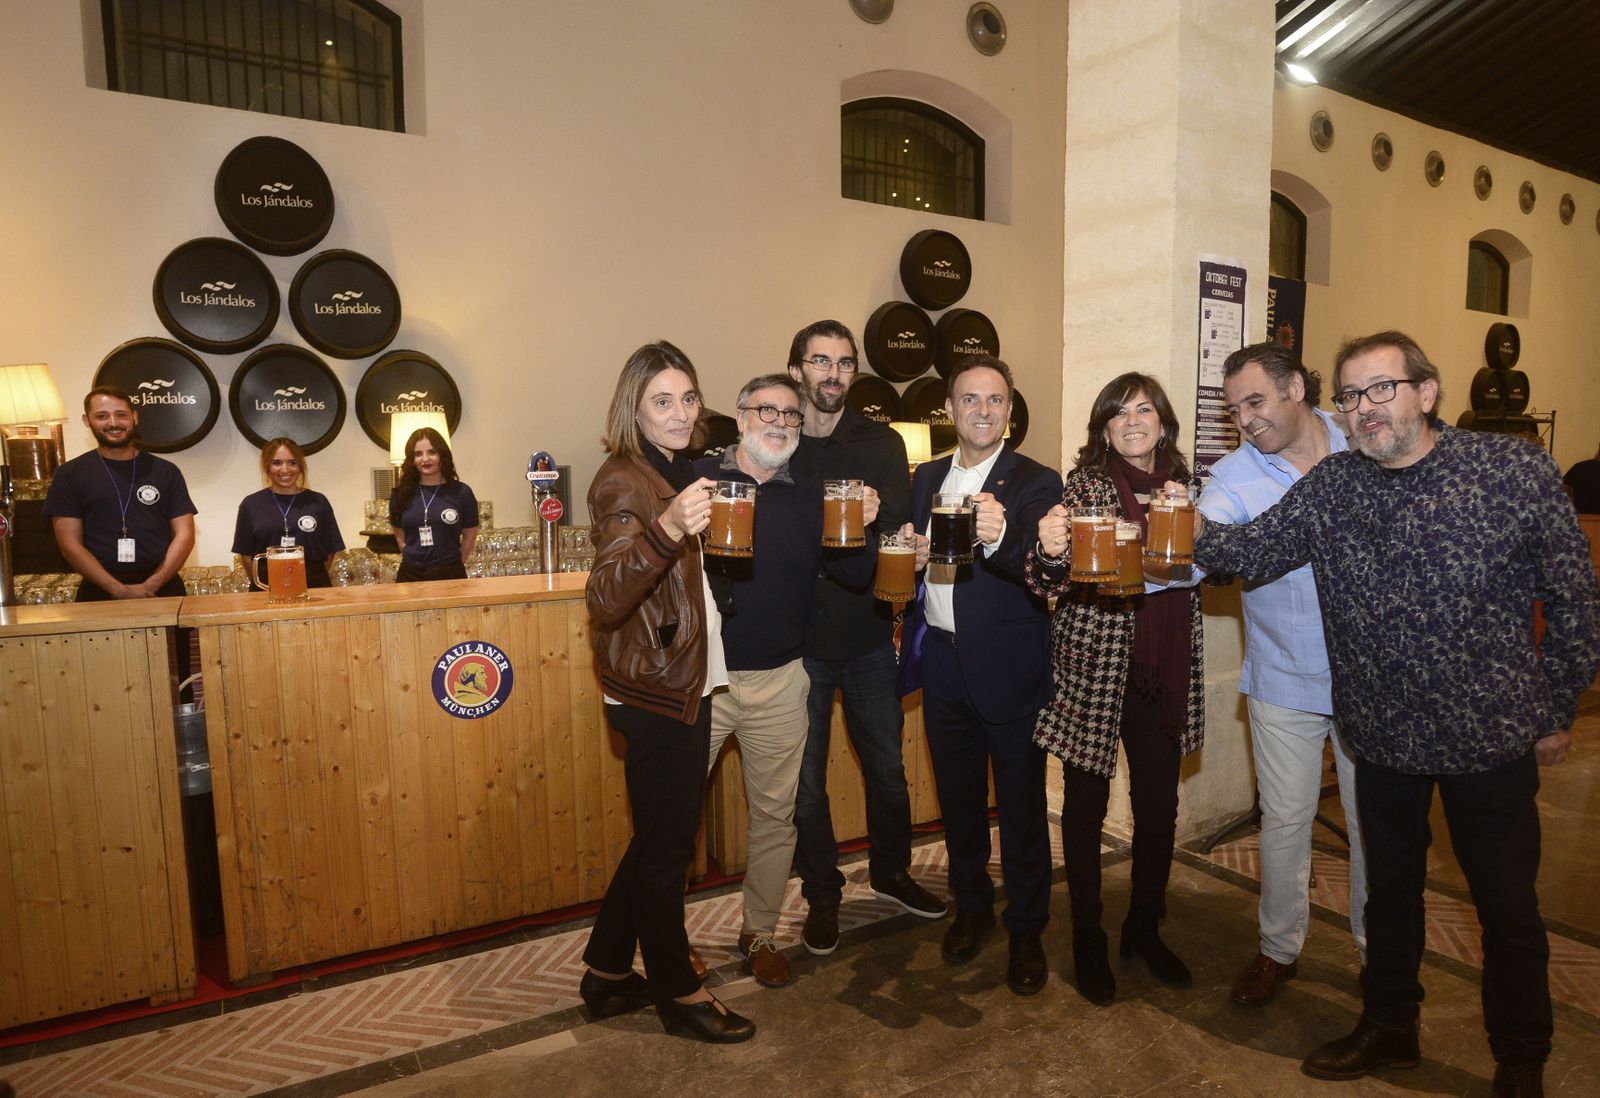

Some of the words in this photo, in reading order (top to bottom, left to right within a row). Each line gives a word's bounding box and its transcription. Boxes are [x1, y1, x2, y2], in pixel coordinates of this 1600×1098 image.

[241, 193, 262, 206] Los
[263, 192, 314, 209] Jándalos
[923, 266, 934, 277] Los
[934, 267, 961, 280] Jándalos
[1205, 271, 1229, 286] OKTOBER
[1230, 275, 1243, 288] FEST
[180, 291, 202, 305] Los
[203, 292, 256, 308] Jándalos
[1211, 288, 1234, 299] CERVEZAS
[314, 302, 334, 315] Los
[334, 301, 382, 316] Jándalos
[887, 339, 899, 349] Los
[899, 339, 926, 350] Jándalos
[953, 344, 964, 353] Los
[129, 394, 141, 405] os
[141, 391, 196, 406] Jándalos
[255, 398, 275, 411] Los
[276, 396, 326, 412] Jándalos
[380, 401, 399, 414] Los
[399, 400, 445, 414] Jándalos
[931, 416, 956, 425] Jándalo
[437, 643, 509, 672] PAULANER
[440, 696, 501, 716] MÜNCHEN
